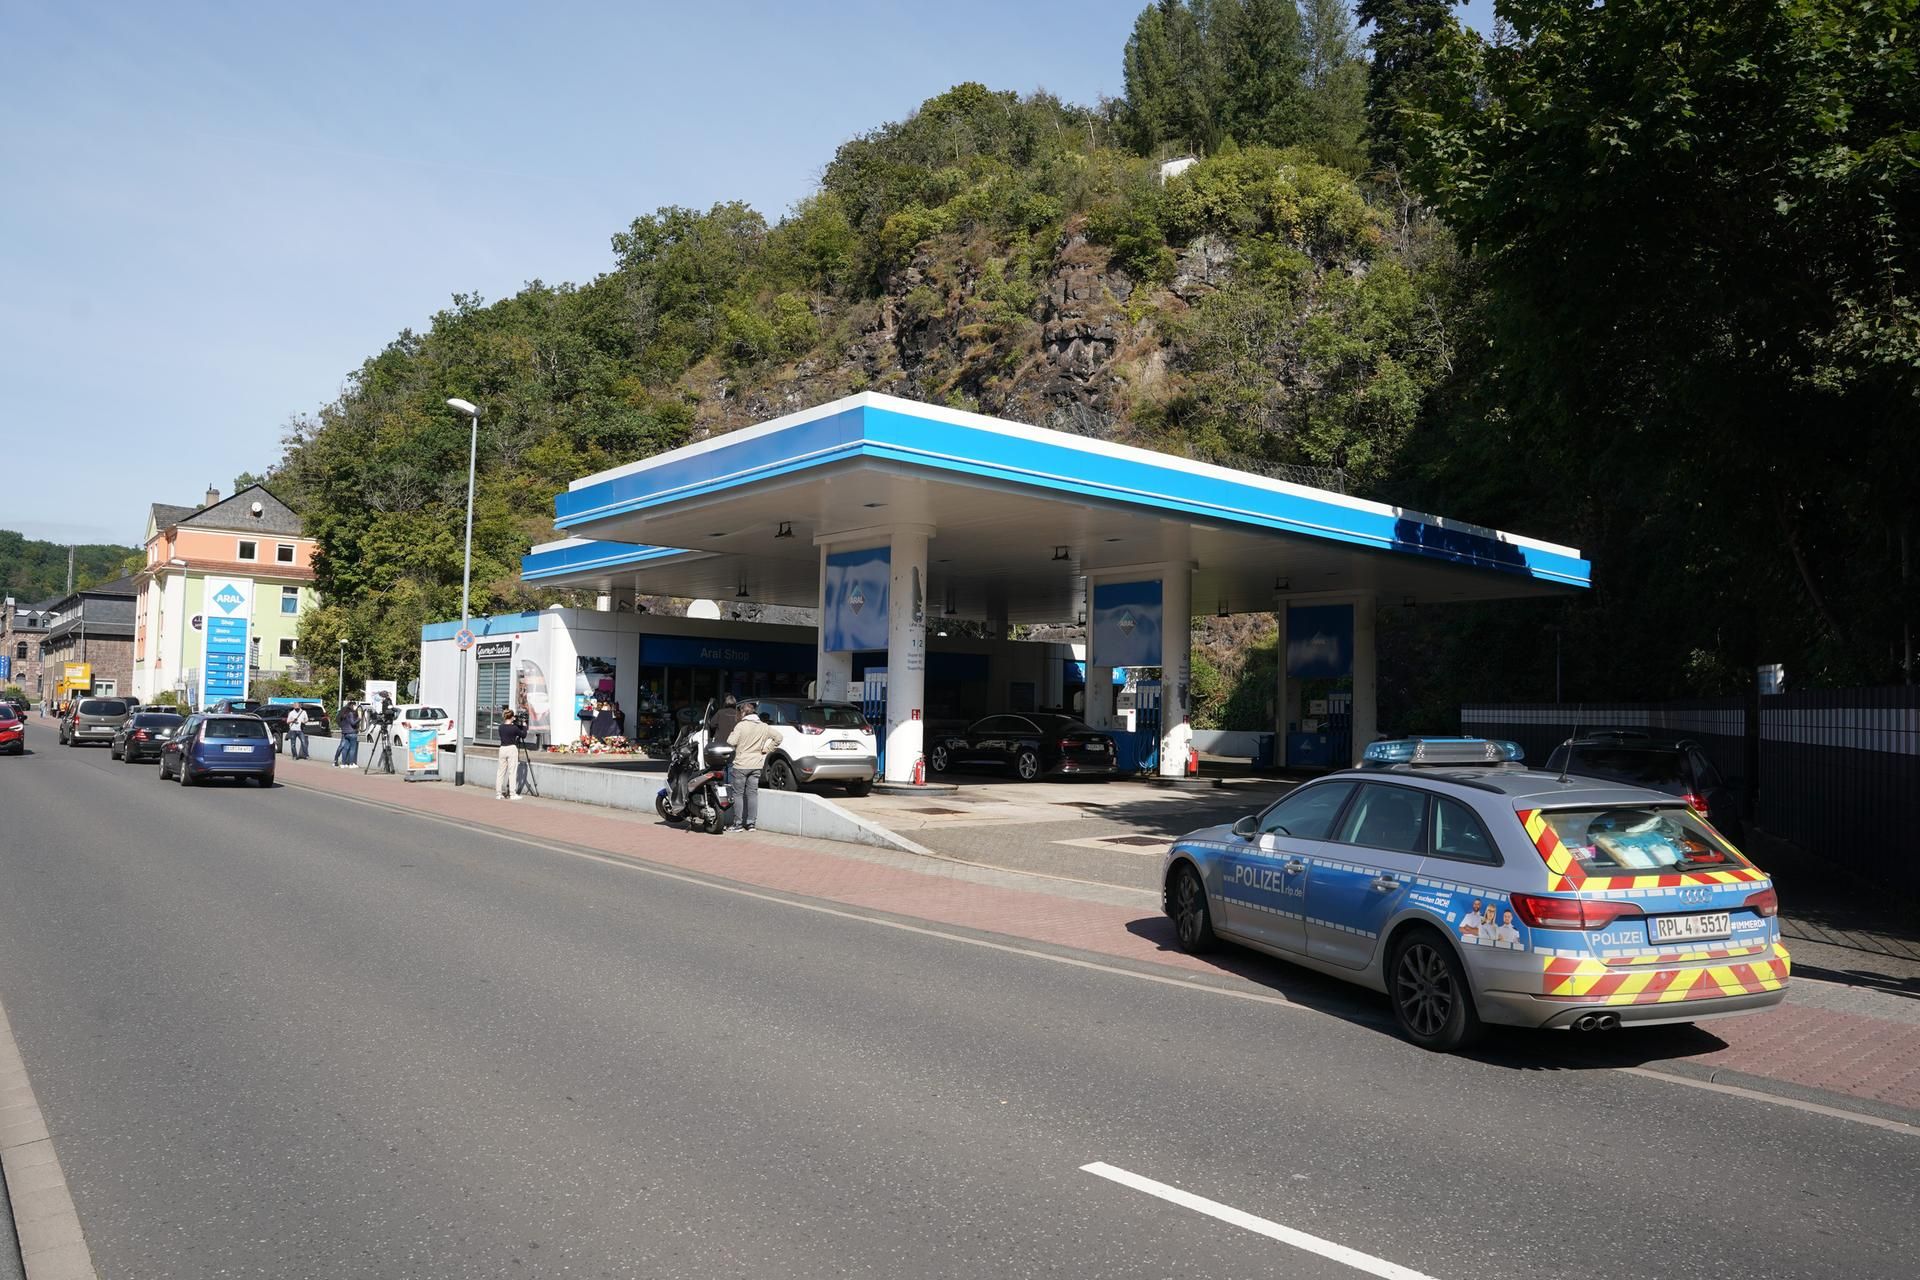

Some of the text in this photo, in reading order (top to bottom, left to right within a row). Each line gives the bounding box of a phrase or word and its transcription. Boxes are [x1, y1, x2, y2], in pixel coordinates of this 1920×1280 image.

[217, 594, 241, 604] ARAL
[849, 596, 864, 604] ARAL
[700, 647, 750, 662] Aral Shop
[1658, 915, 1728, 937] RPL 4 5517
[1731, 919, 1766, 930] #IMMERDA
[1591, 931, 1644, 946] POLIZEI
